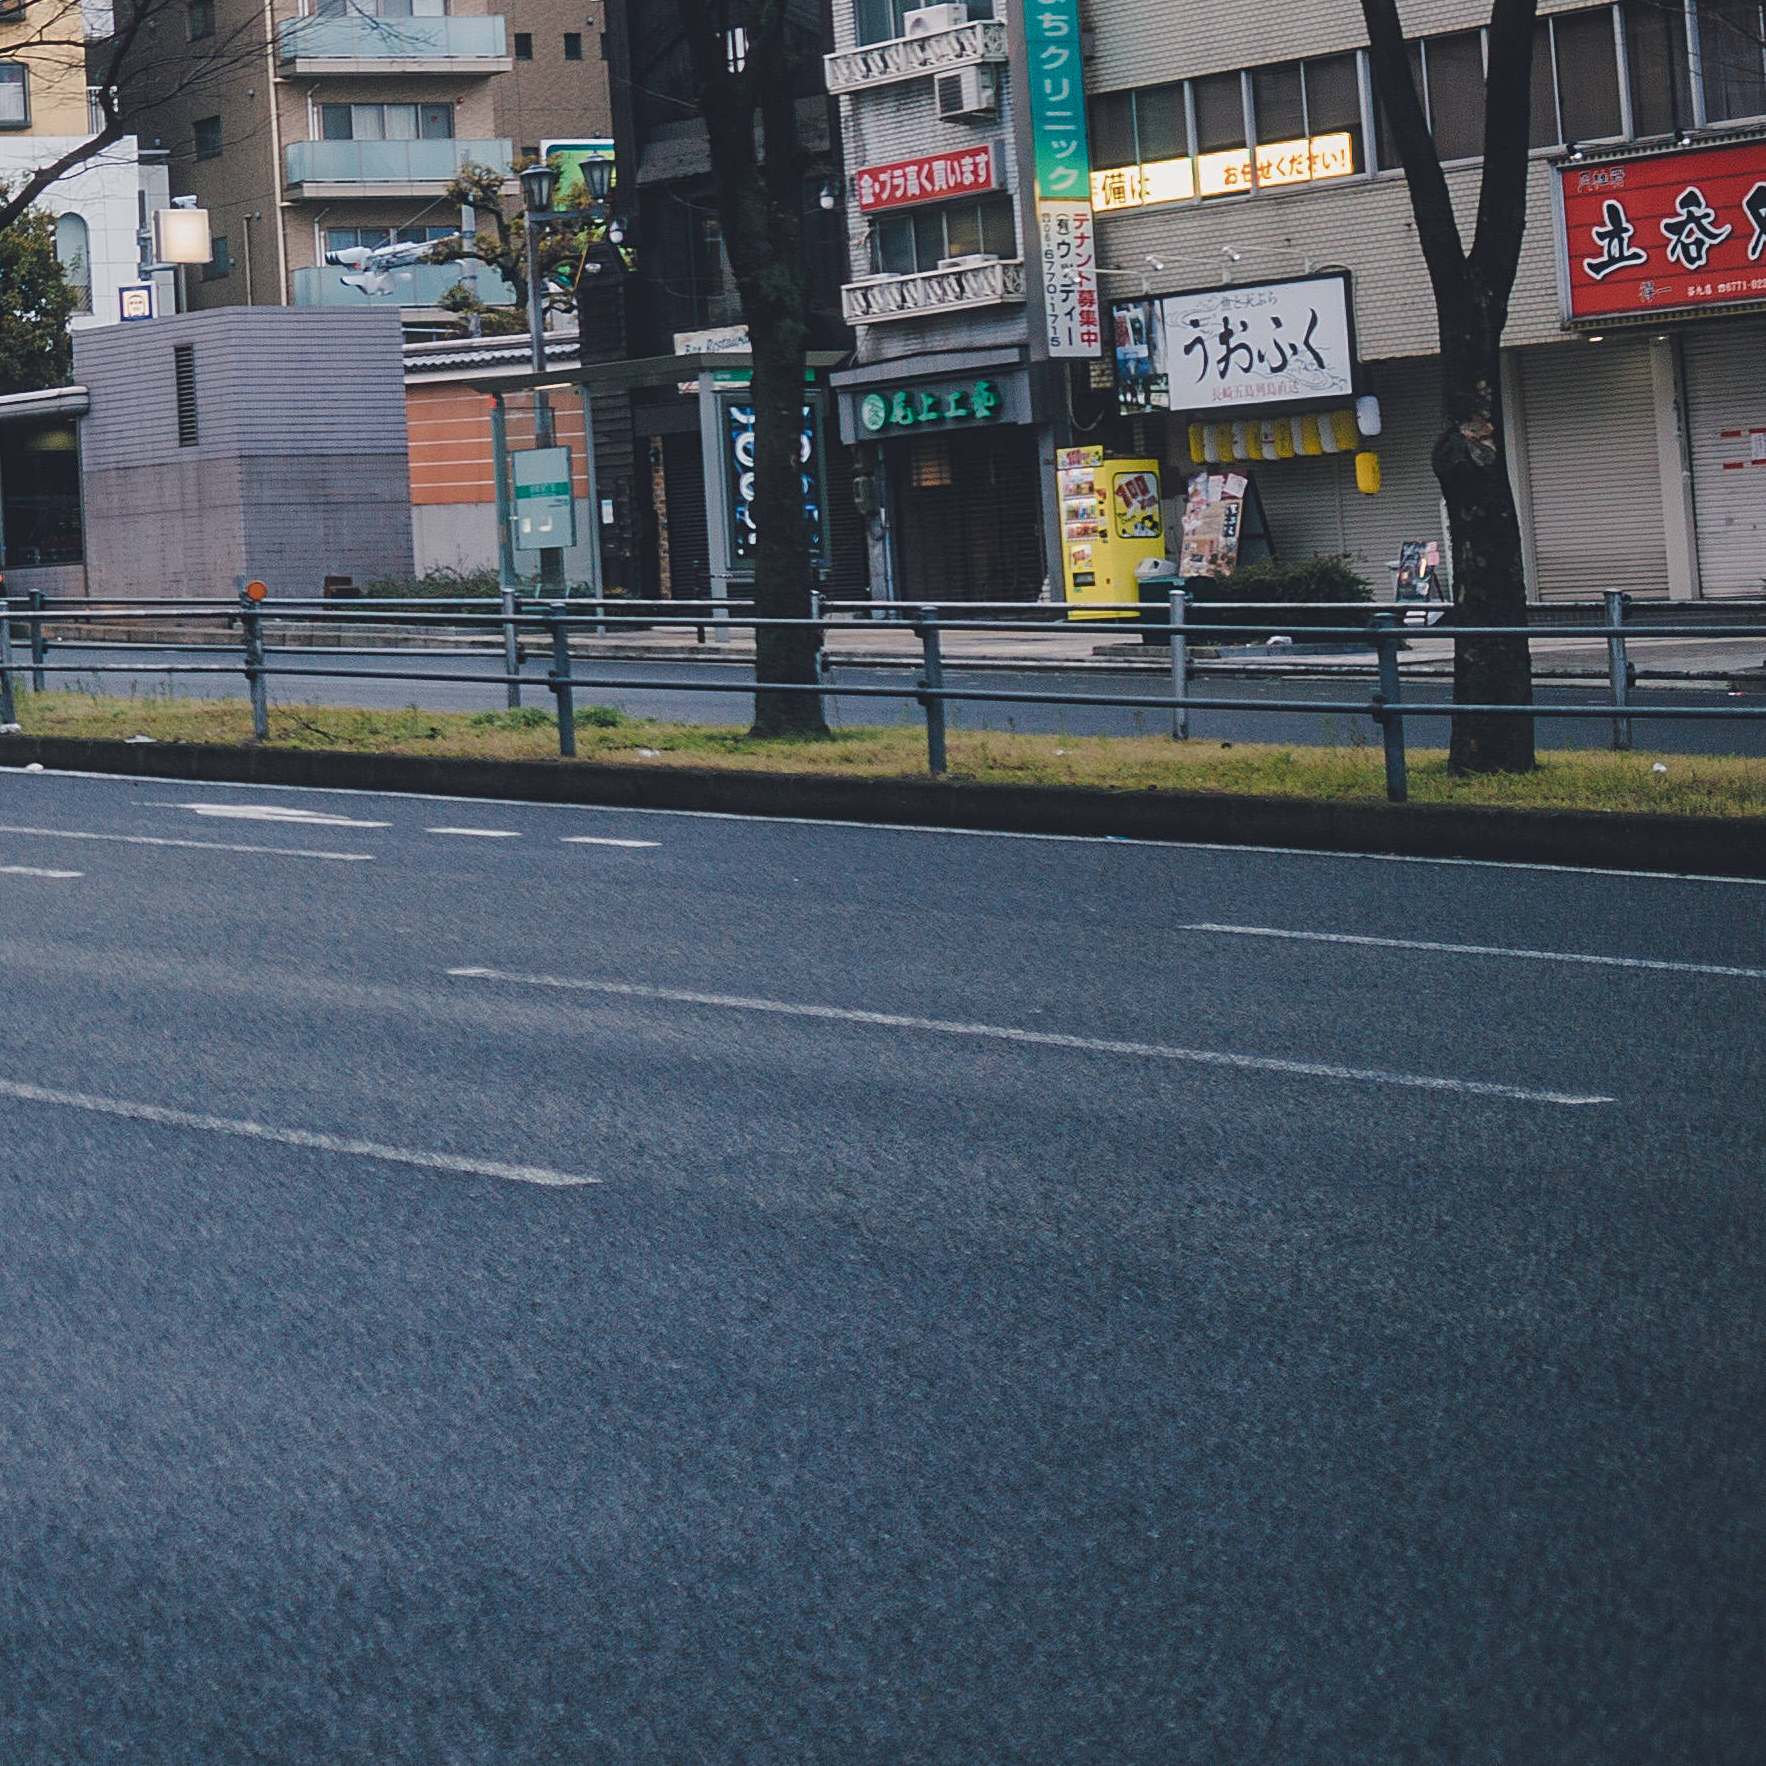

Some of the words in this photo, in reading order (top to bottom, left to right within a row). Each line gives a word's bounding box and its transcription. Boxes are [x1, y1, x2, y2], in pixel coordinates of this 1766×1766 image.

[859, 152, 991, 205] 金・プラ高く買います
[1093, 171, 1152, 205] 備は
[1073, 212, 1099, 348] テナント募集中
[1183, 307, 1326, 385] うおふく
